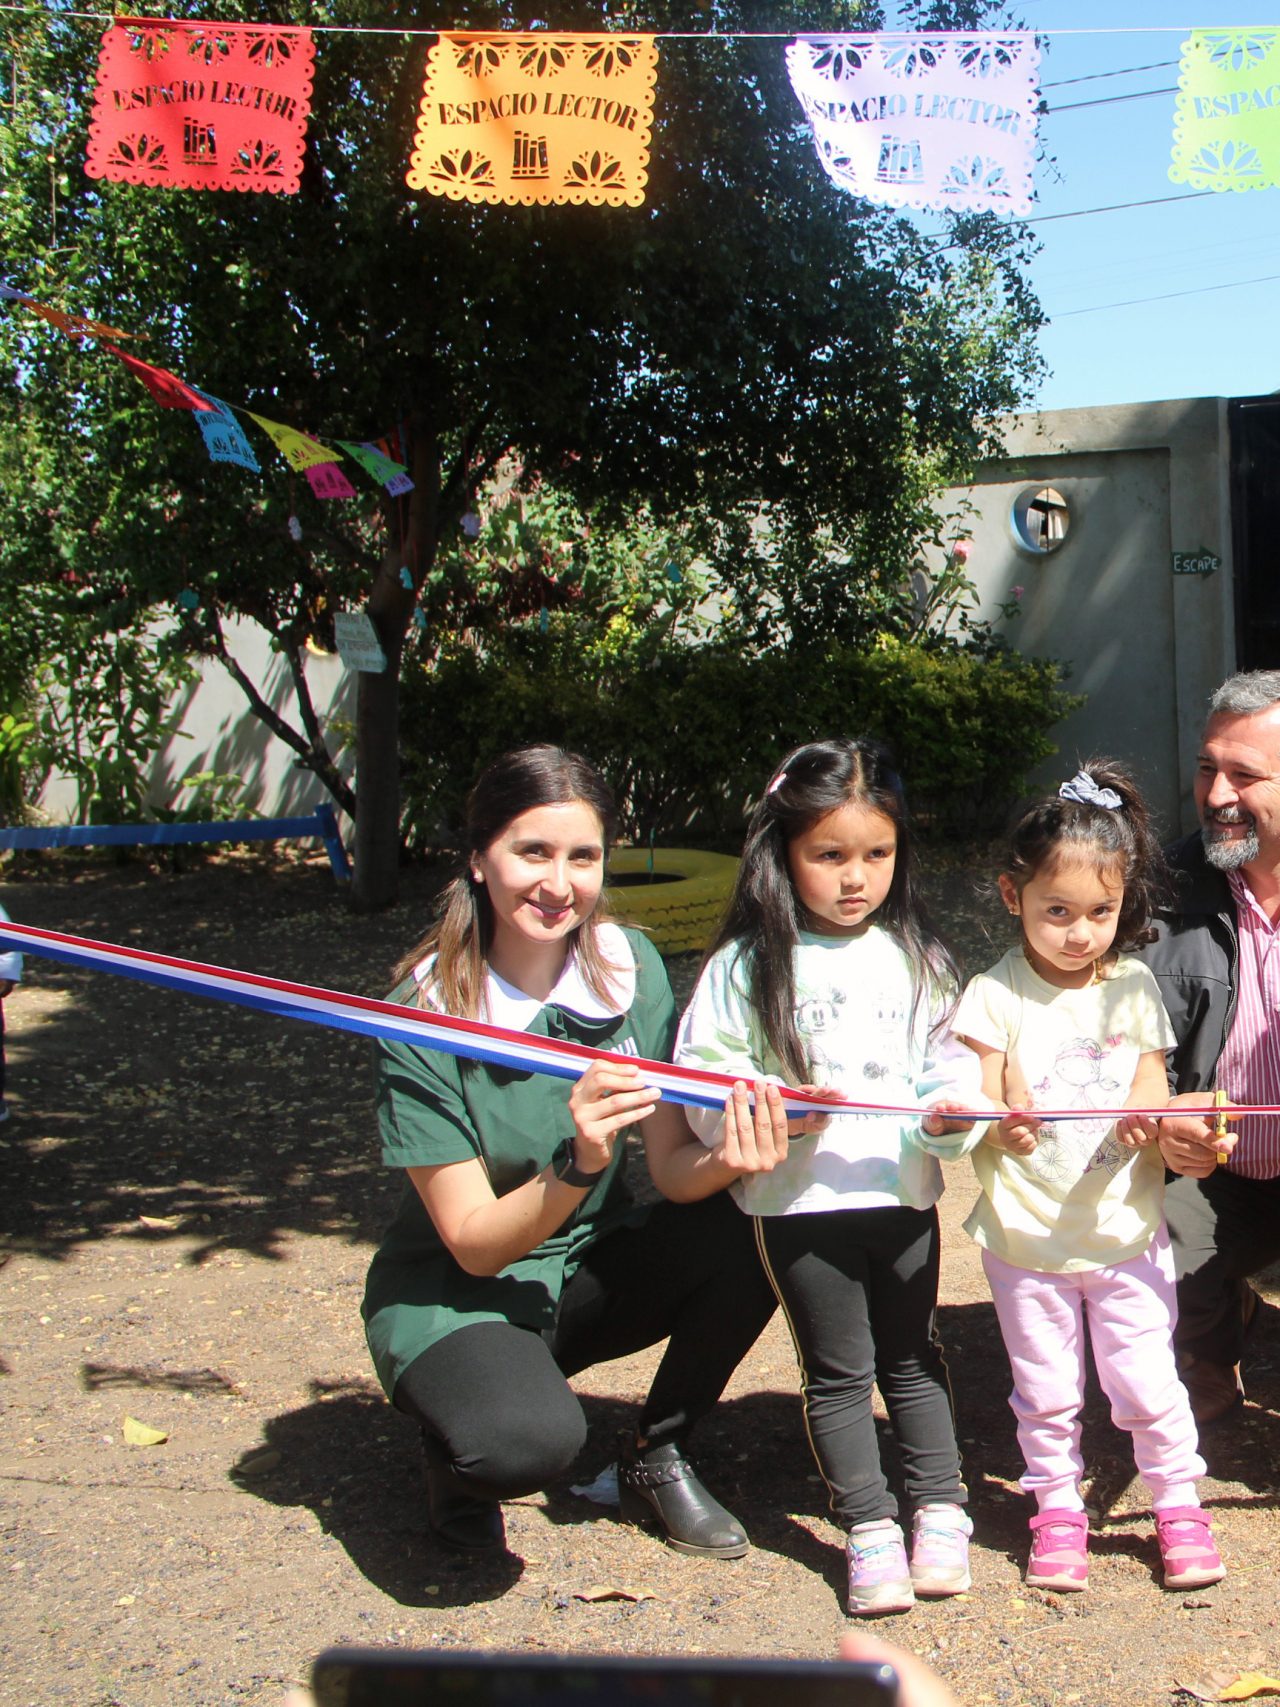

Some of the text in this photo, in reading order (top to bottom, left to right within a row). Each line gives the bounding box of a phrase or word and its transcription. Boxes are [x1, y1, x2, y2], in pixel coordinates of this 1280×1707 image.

[111, 79, 298, 122] ESPACIO LECTOR
[437, 91, 639, 132] ESPACIO LECTOR
[914, 93, 1021, 137] LECTOR
